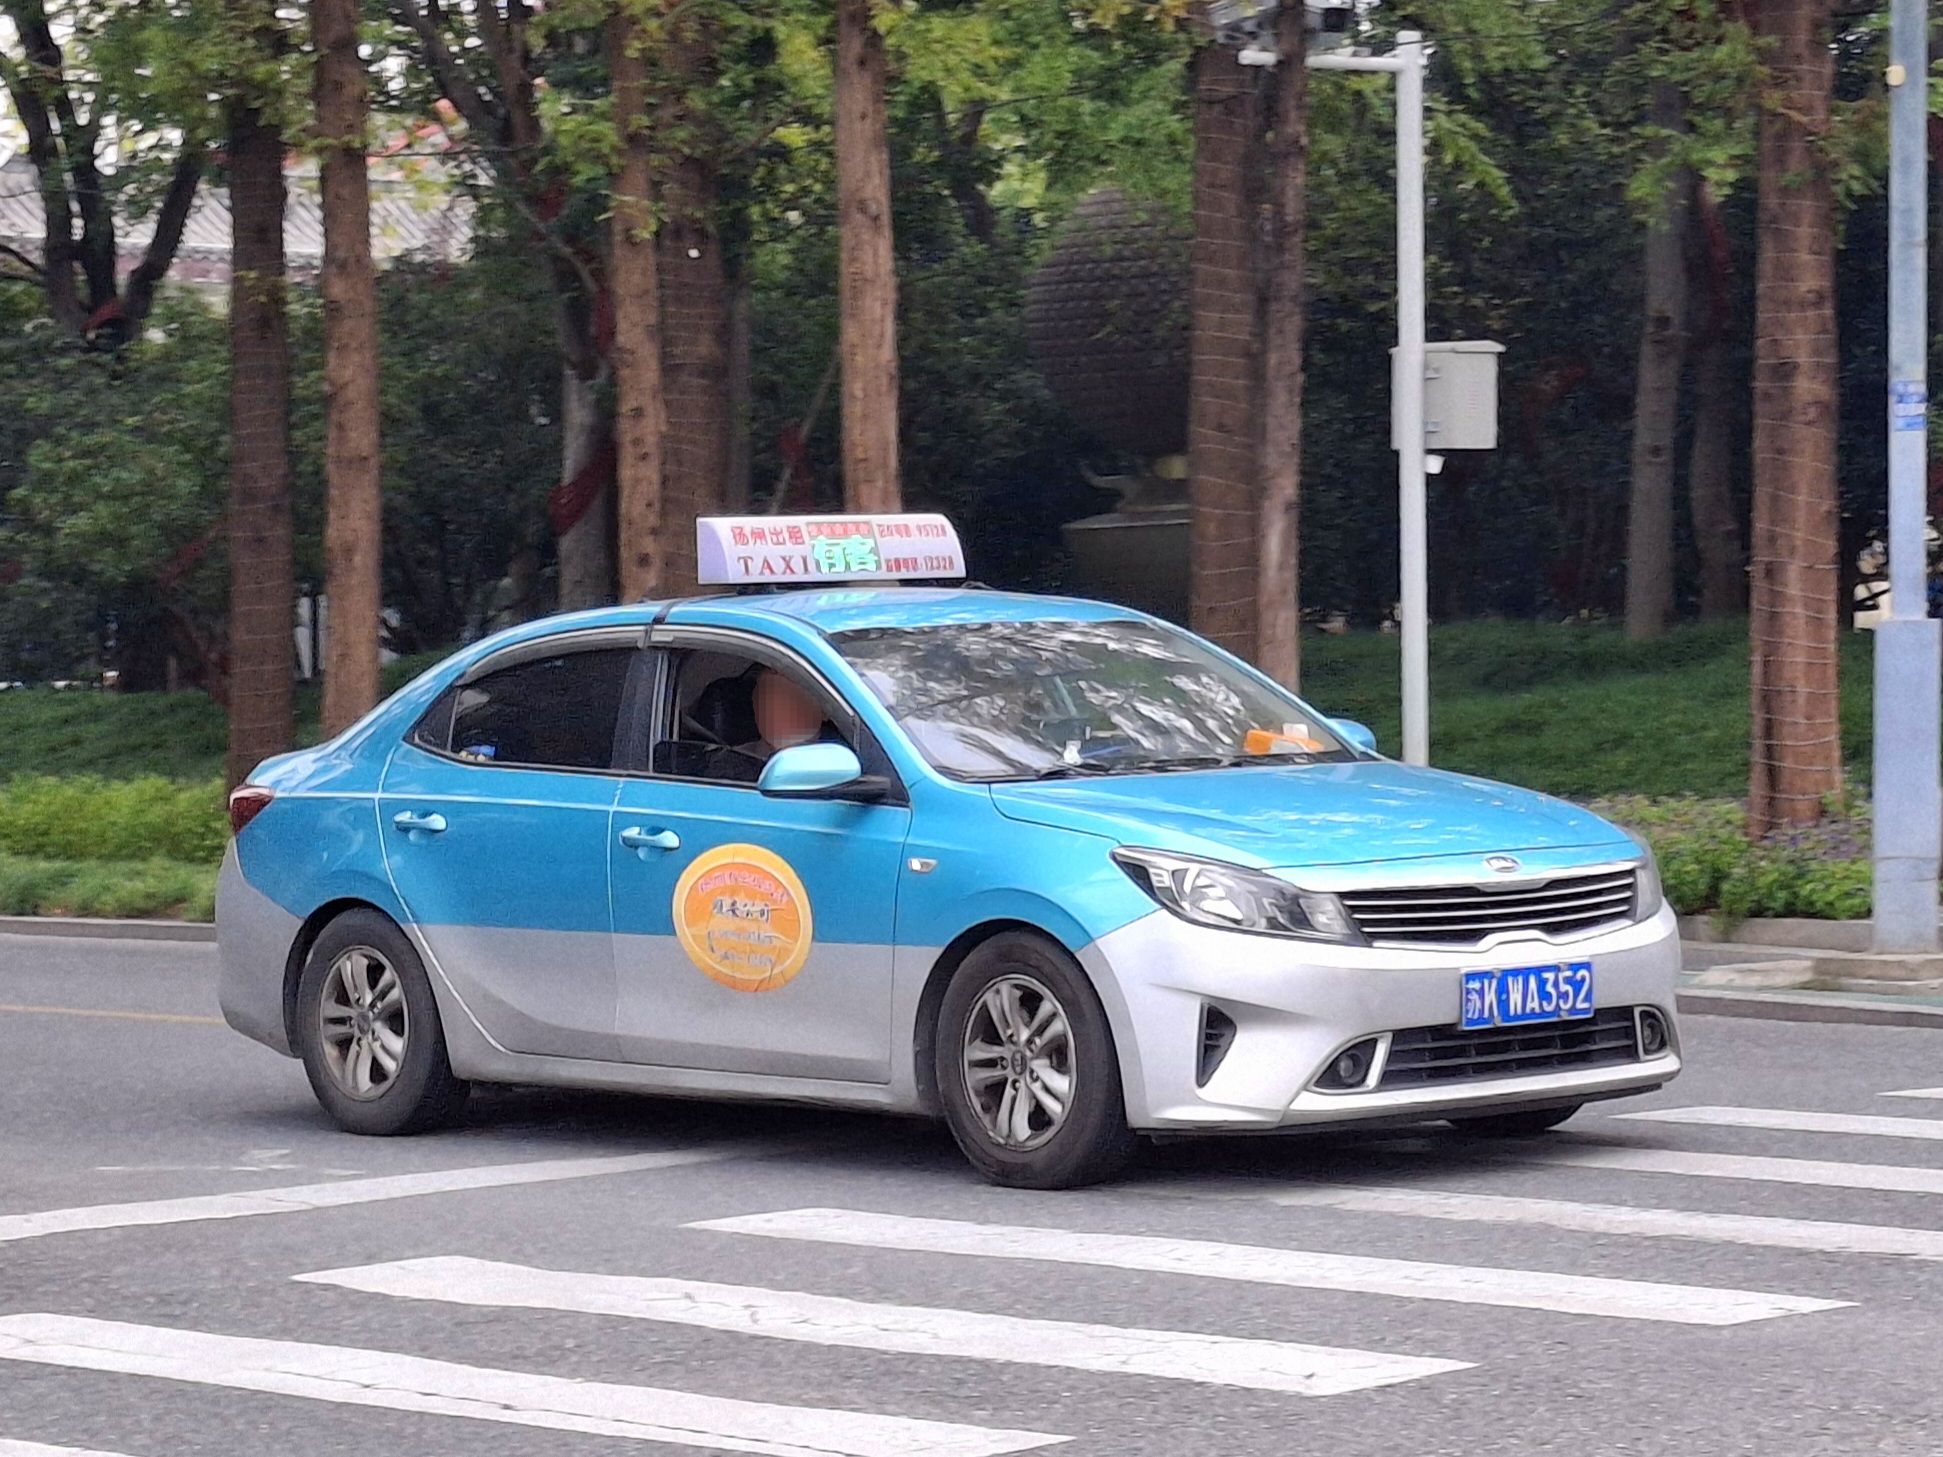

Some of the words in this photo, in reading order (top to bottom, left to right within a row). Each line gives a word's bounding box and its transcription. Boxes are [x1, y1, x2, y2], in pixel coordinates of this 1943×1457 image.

[730, 525, 806, 546] 扬州出租
[737, 555, 812, 577] TAXI
[923, 555, 955, 572] 12328
